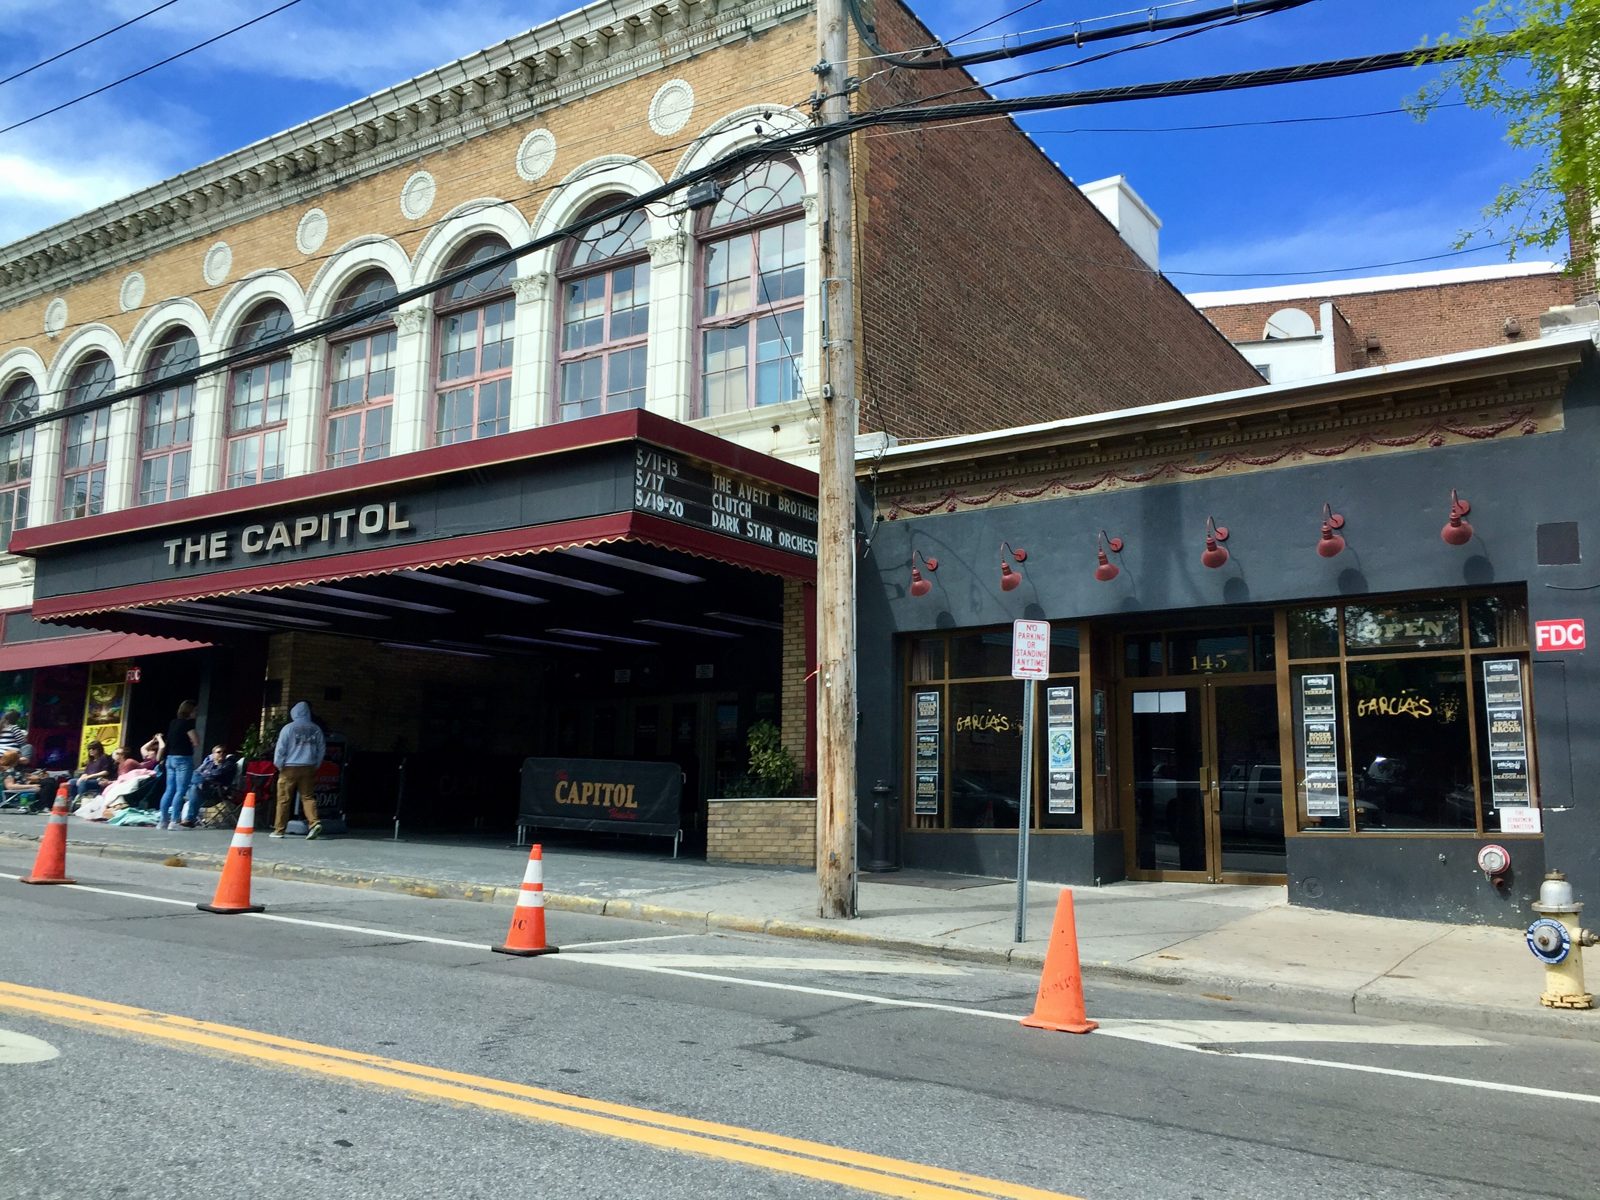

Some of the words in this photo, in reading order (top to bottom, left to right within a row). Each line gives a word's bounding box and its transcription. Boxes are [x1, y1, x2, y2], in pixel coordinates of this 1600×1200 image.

[636, 450, 678, 477] 5/11-13
[712, 474, 731, 494] THE
[738, 484, 770, 507] AVETT
[635, 468, 664, 492] 5/17
[712, 494, 752, 519] CLUTCH
[635, 489, 684, 518] 5/19-20
[711, 510, 739, 534] DARK
[747, 522, 773, 543] STAR
[163, 531, 228, 565] THE
[241, 502, 409, 554] CAPITOL
[1017, 632, 1045, 641] PARKING
[1362, 620, 1444, 639] OPEN
[1535, 623, 1584, 647] FDC
[1015, 649, 1047, 658] STANDING
[1017, 659, 1045, 667] ANYTIME
[1191, 654, 1228, 671] 145
[127, 669, 141, 681] FDC
[555, 780, 638, 809] CAPITOL
